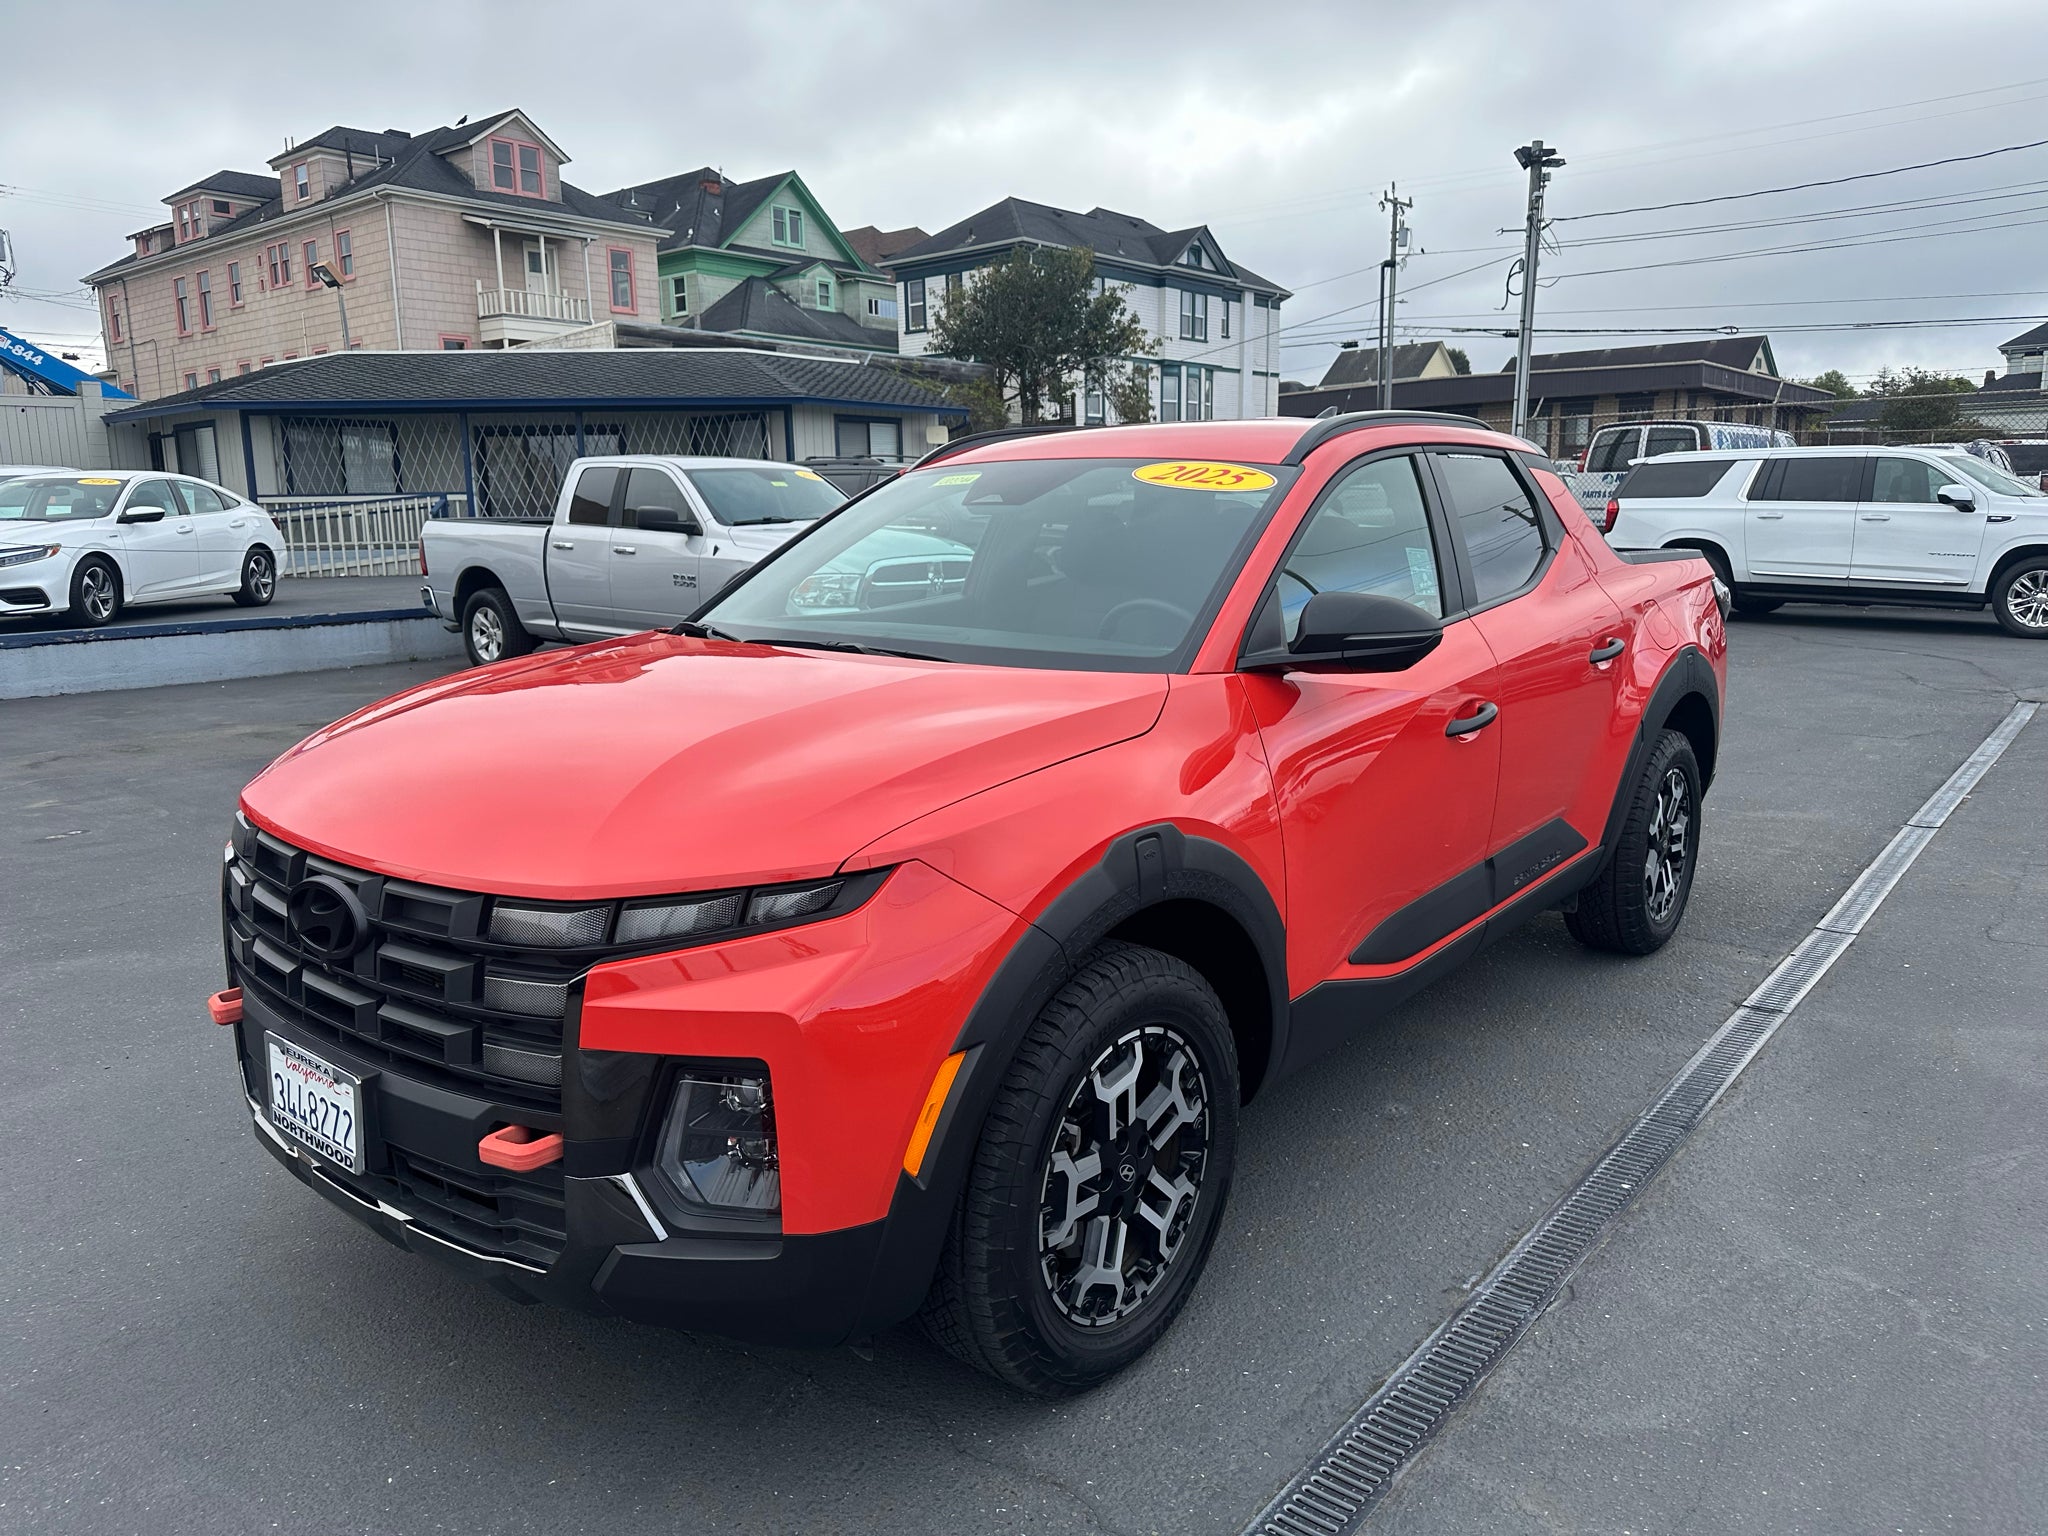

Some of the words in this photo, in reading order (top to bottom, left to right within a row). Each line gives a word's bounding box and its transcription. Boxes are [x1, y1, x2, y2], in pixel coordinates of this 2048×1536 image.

[1149, 465, 1257, 486] 2025
[1582, 490, 1601, 498] PARTS
[673, 573, 697, 581] RAM
[673, 580, 697, 589] 1500
[286, 1047, 331, 1077] EUREKA
[285, 1056, 341, 1095] California
[273, 1110, 354, 1169] NORTHWOOD
